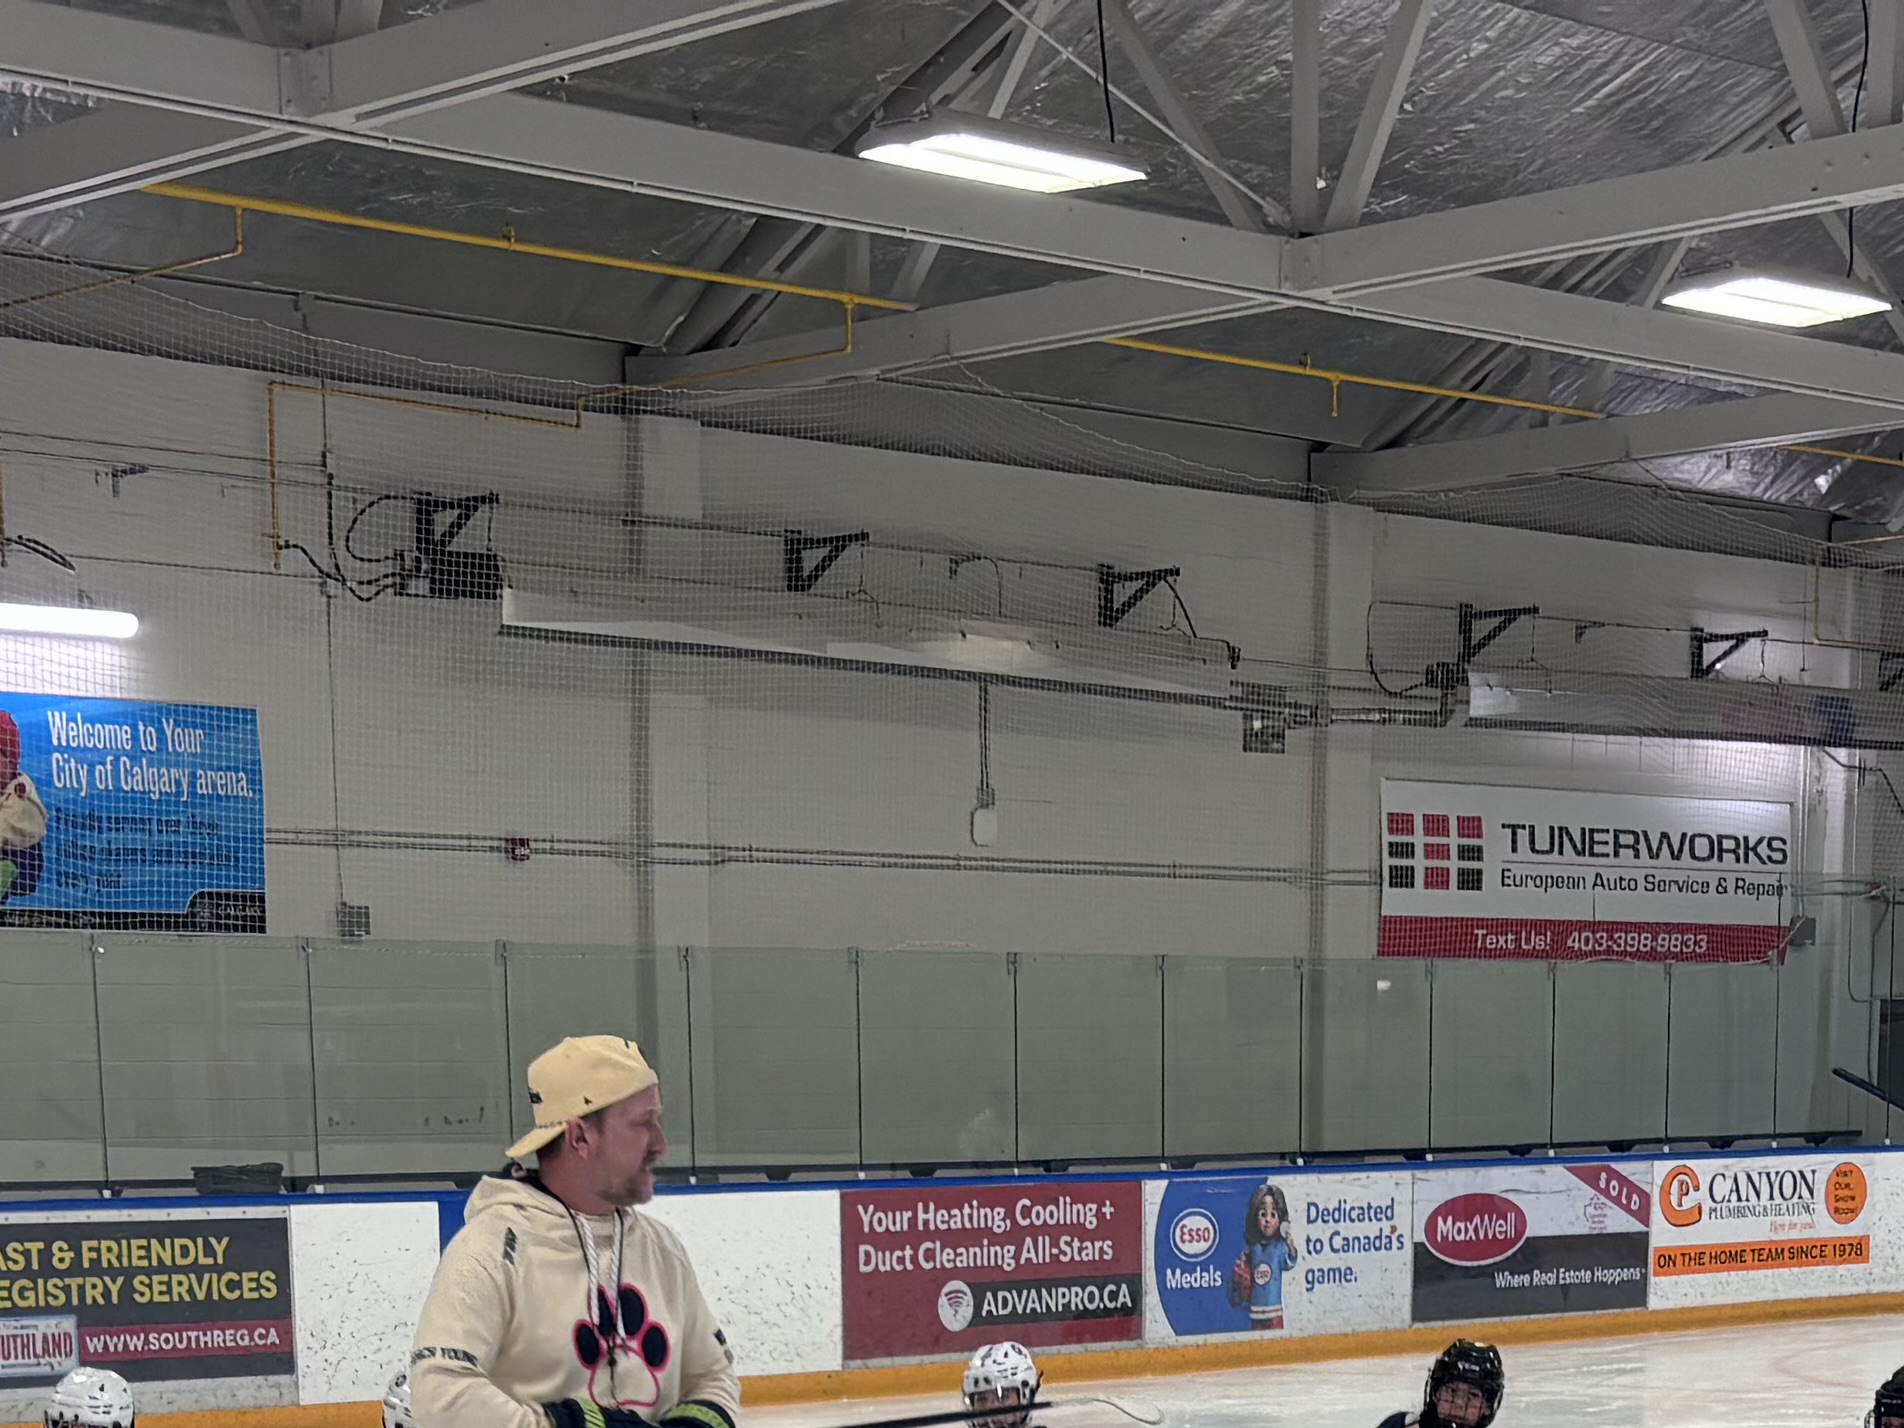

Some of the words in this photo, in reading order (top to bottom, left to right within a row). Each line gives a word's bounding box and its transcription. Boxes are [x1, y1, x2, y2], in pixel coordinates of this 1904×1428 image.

[47, 709, 132, 754] Welcome
[138, 719, 158, 753] to
[161, 716, 205, 755] Your
[50, 753, 89, 799] City
[95, 756, 114, 791] of
[119, 758, 191, 802] Calgary
[196, 770, 253, 798] arena.
[1500, 821, 1789, 866] TUNERWORKS
[1500, 867, 1587, 894] European
[1593, 870, 1639, 893] Auto
[1644, 874, 1710, 895] Service
[1715, 876, 1729, 895] &
[1734, 876, 1788, 900] Repair
[1474, 929, 1515, 951] Text
[1520, 929, 1552, 952] Us!
[1567, 931, 1708, 954] 403-398-9833
[1599, 1171, 1640, 1211] SOLD
[1708, 1169, 1817, 1205] CANYON
[857, 1203, 910, 1234] Your
[916, 1200, 1012, 1234] Heating,
[1015, 1196, 1098, 1231] Cooling
[1102, 1200, 1115, 1220] +
[1306, 1198, 1395, 1225] Dedicated
[1437, 1211, 1516, 1245] MaxWell
[52, 1240, 75, 1269] &
[81, 1235, 230, 1269] FRIENDLY
[858, 1244, 917, 1273] Duct
[919, 1237, 1016, 1273] Cleaning
[1020, 1234, 1113, 1264] All-Stars
[1306, 1234, 1325, 1257] to
[1328, 1229, 1405, 1255] Canada's
[1657, 1254, 1677, 1269] ON
[1680, 1252, 1705, 1266] THE
[1709, 1249, 1747, 1265] HOME
[1750, 1247, 1785, 1262] TEAM
[1787, 1244, 1828, 1260] SINCE
[1832, 1242, 1863, 1258] 1978
[132, 1270, 278, 1304] SERVICES
[1166, 1267, 1222, 1291] Medals
[1304, 1267, 1358, 1292] game.
[1494, 1270, 1531, 1288] Where
[1533, 1269, 1556, 1287] Real
[1559, 1268, 1592, 1286] Estate
[1594, 1266, 1642, 1286] Happens
[981, 1285, 1132, 1316] ADVANPRO.CA
[85, 1327, 280, 1354] WWW.SOUTHREG.CA
